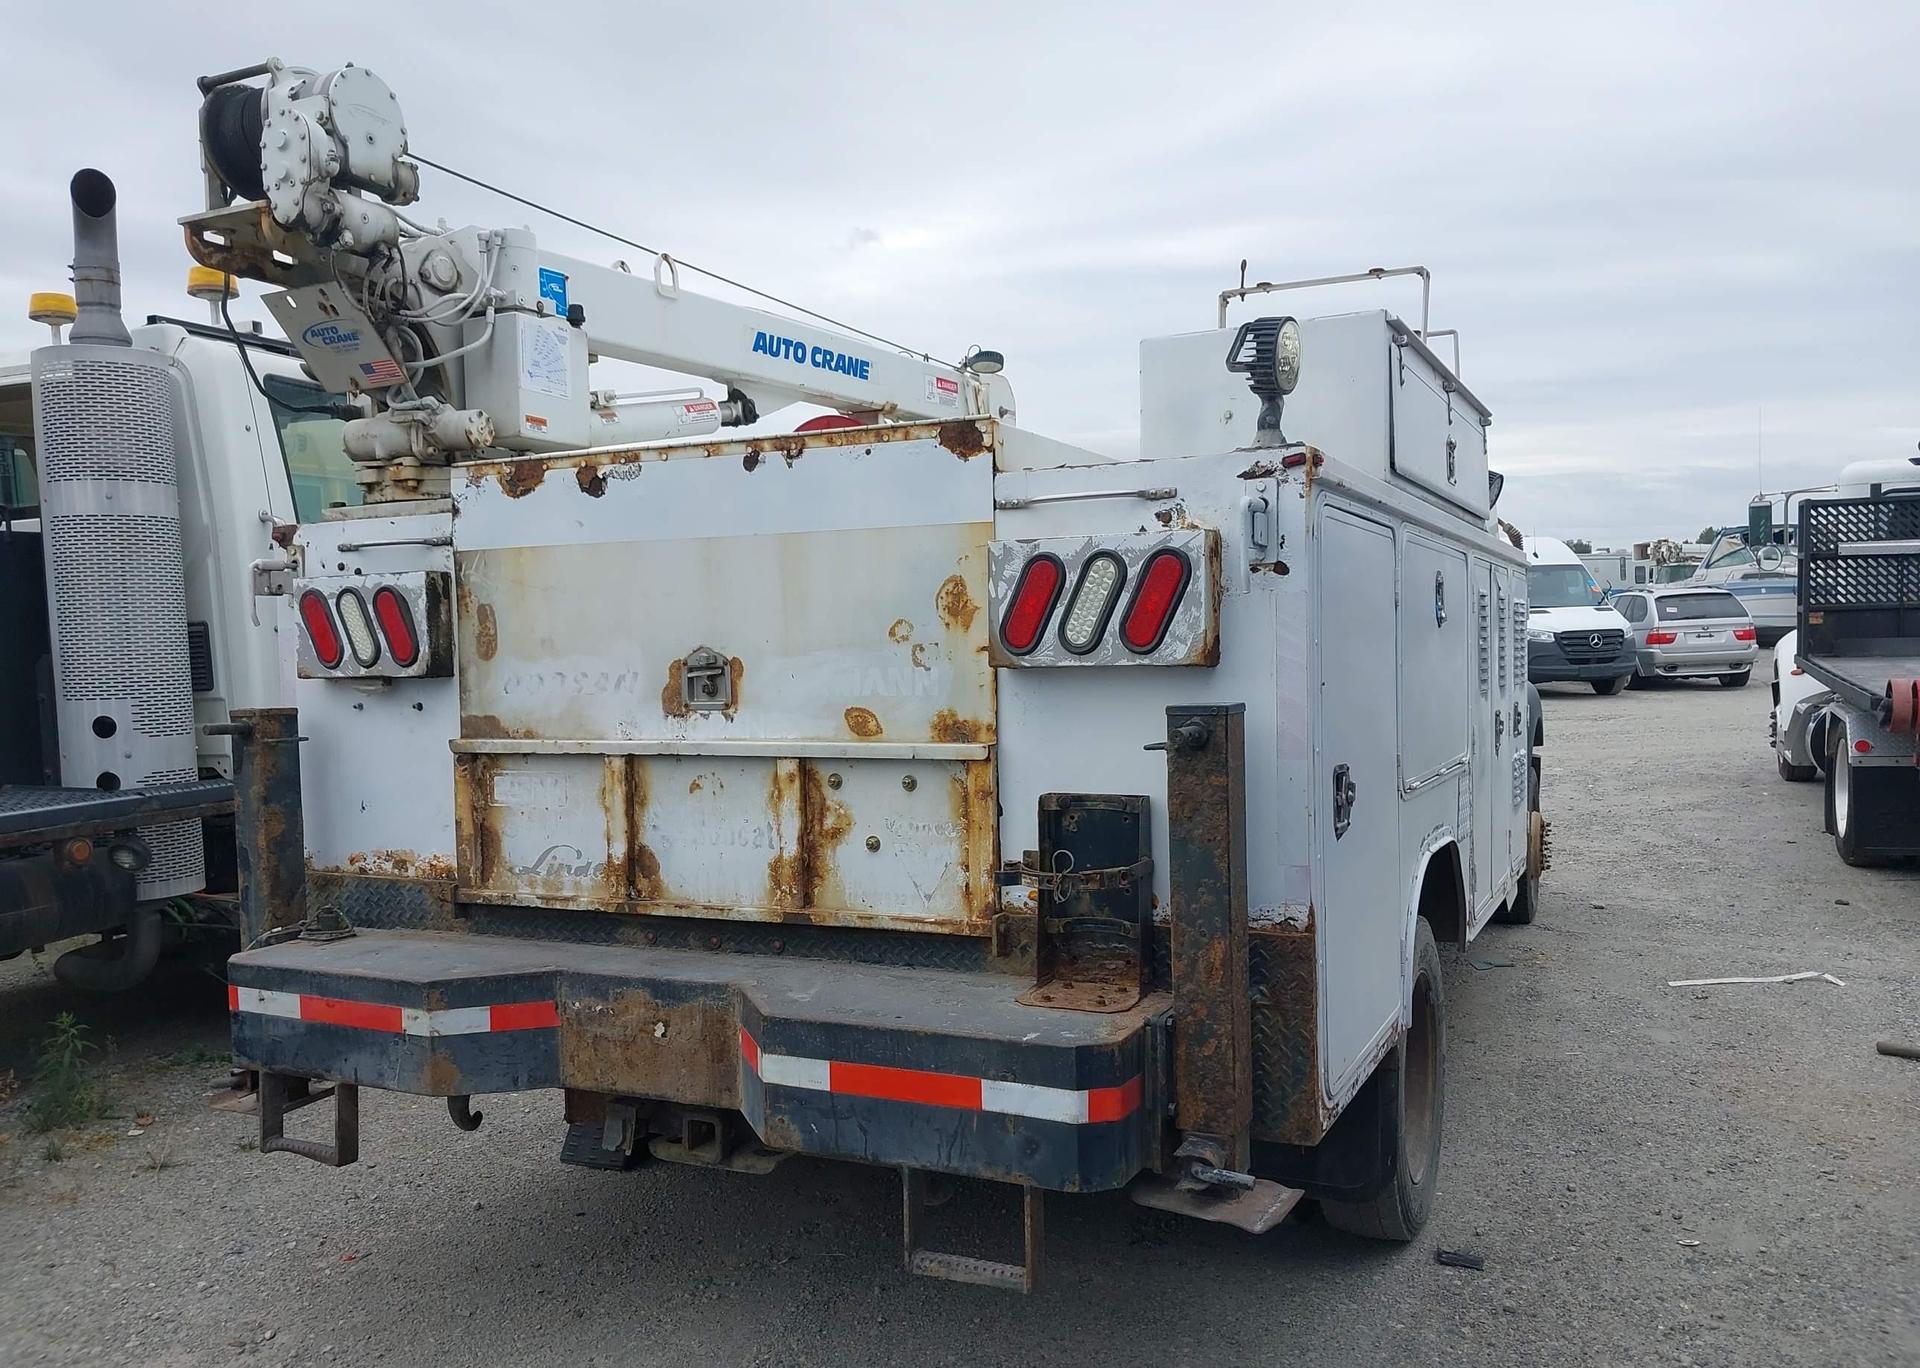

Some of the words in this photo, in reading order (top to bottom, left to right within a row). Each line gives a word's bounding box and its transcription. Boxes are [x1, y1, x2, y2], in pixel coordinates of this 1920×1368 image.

[310, 326, 339, 339] AUTO
[322, 331, 360, 346] CRANE
[752, 331, 806, 364] AUTO
[811, 346, 870, 380] CRANE
[693, 403, 714, 412] DANGER
